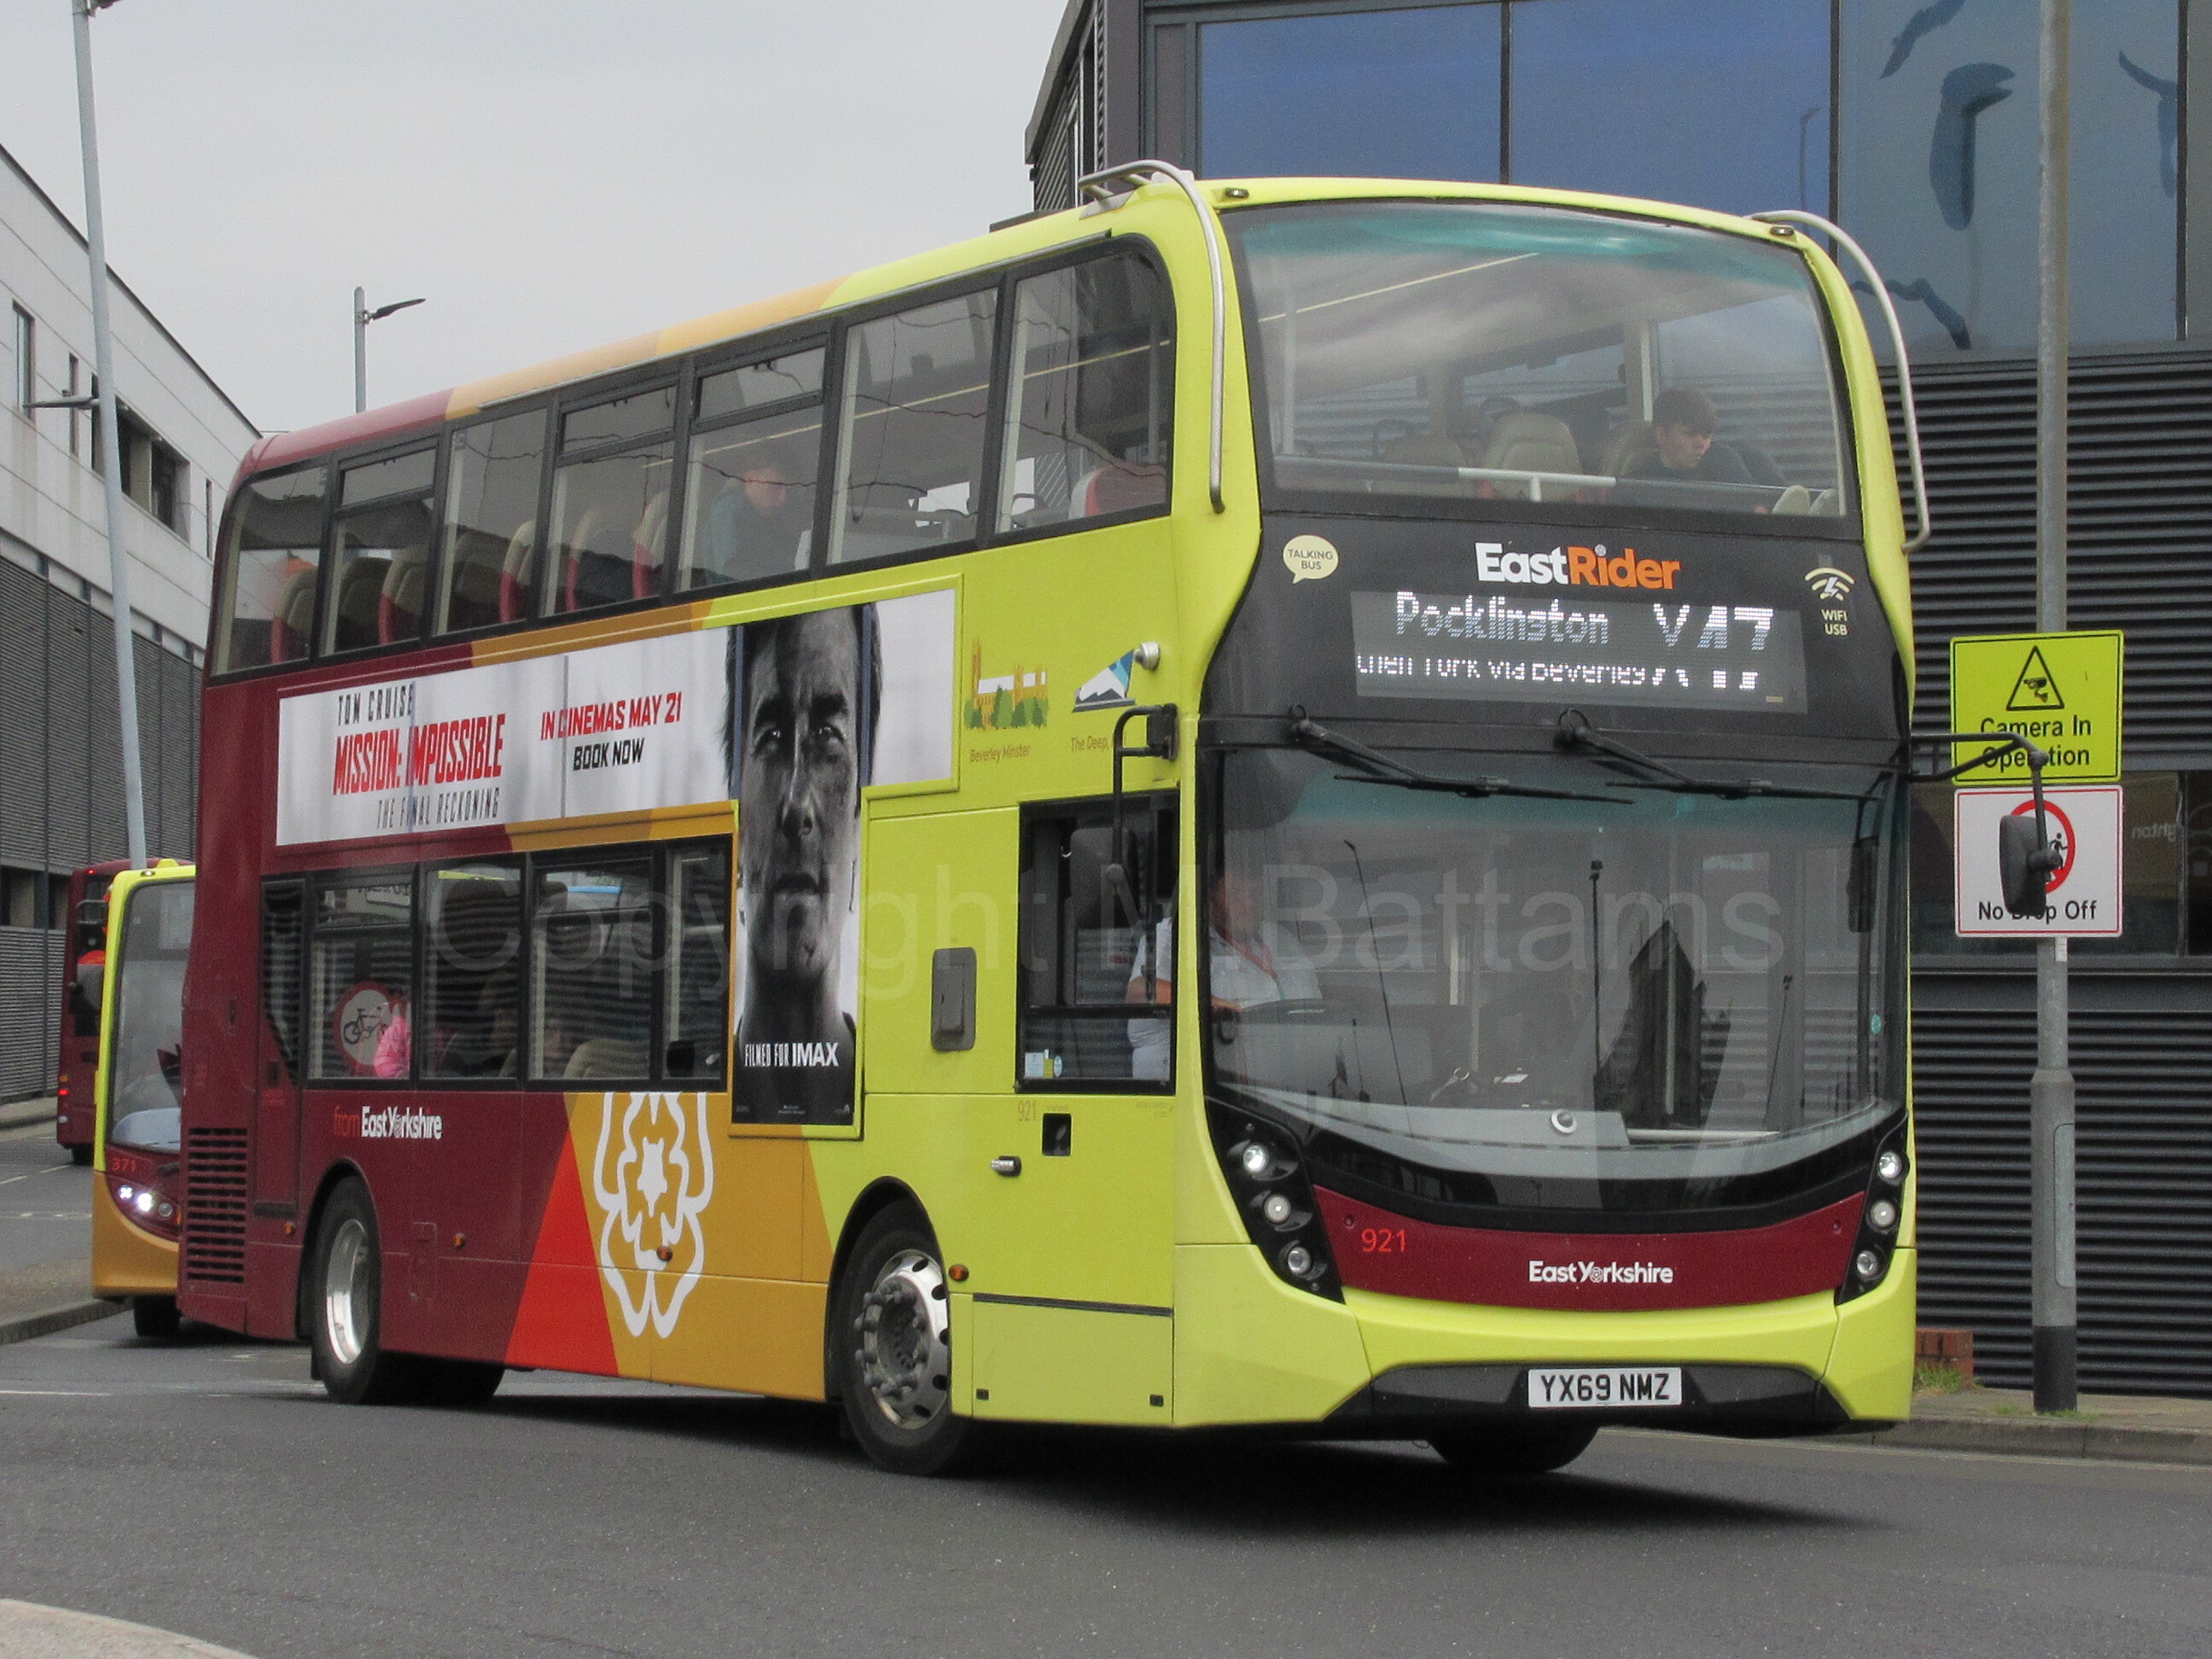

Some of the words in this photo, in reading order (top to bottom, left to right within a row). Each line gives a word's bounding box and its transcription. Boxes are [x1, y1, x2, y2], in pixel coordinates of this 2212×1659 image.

[1288, 549, 1334, 561] TALKING
[1301, 561, 1322, 571] BUS
[1475, 542, 1680, 590] EastRider
[1396, 591, 1609, 645] Pocklington
[1820, 608, 1848, 622] WIFI
[1825, 622, 1848, 636] USB
[338, 692, 361, 726] TOM
[540, 710, 556, 741] IN
[557, 700, 626, 738] CINEMAS
[629, 695, 662, 729] MAY
[664, 691, 682, 724] 21
[1980, 717, 2064, 738] Camera
[2072, 714, 2092, 736] In
[332, 728, 403, 795] MISSION:
[405, 713, 506, 788] IMPOSSIBLE
[573, 742, 610, 771] BOOK
[612, 737, 645, 766] NOW
[969, 747, 1001, 764] Beverley
[1070, 736, 1086, 752] The
[376, 798, 396, 830] THE
[436, 786, 500, 825] RECKONING
[1978, 901, 2003, 921] No
[2064, 899, 2098, 920] Off
[744, 1043, 771, 1068] FILMED
[774, 1043, 789, 1067] FOR
[791, 1041, 840, 1068] IMAX
[1018, 1100, 1037, 1121] 921
[1361, 1229, 1406, 1253] 921
[1540, 1374, 1611, 1402] YX69
[1620, 1373, 1670, 1401] NMZ
